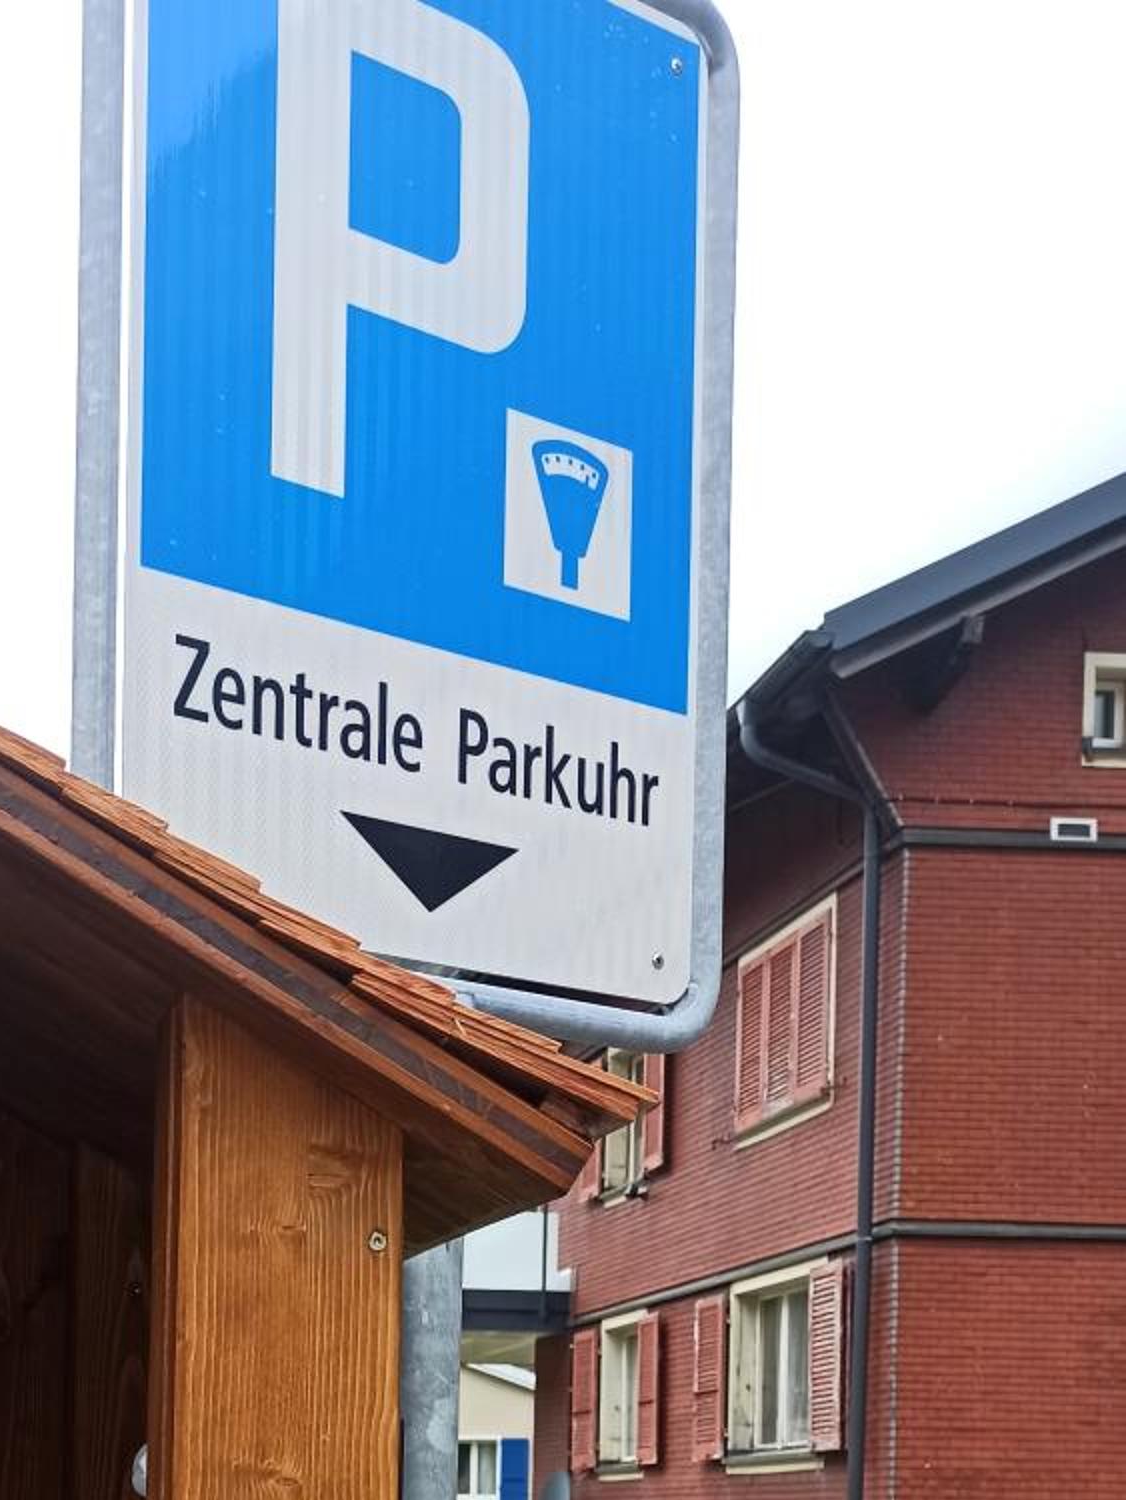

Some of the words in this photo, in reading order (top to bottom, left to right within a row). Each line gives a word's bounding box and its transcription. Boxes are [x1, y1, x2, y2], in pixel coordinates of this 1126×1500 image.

[270, 0, 530, 498] P
[173, 634, 423, 774] Zentrale
[457, 708, 660, 827] Parkuhr
